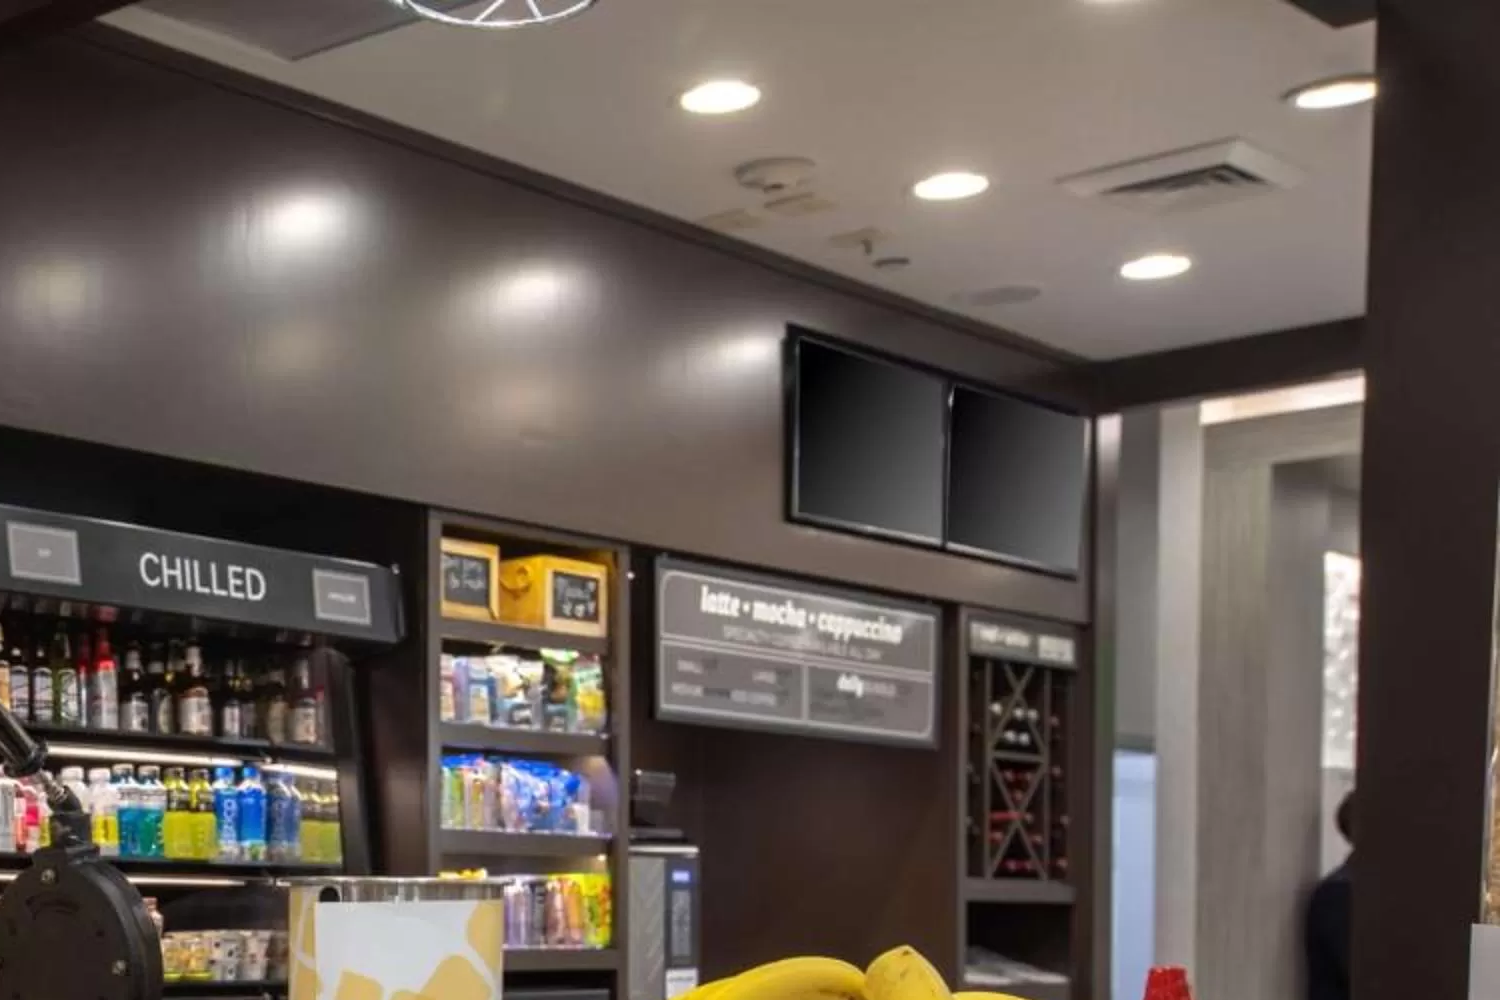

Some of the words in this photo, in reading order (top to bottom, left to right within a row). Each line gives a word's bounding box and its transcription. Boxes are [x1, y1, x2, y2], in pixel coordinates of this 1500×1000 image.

[139, 552, 267, 601] CHILLED
[701, 584, 740, 617] latte
[753, 599, 806, 629] mocha
